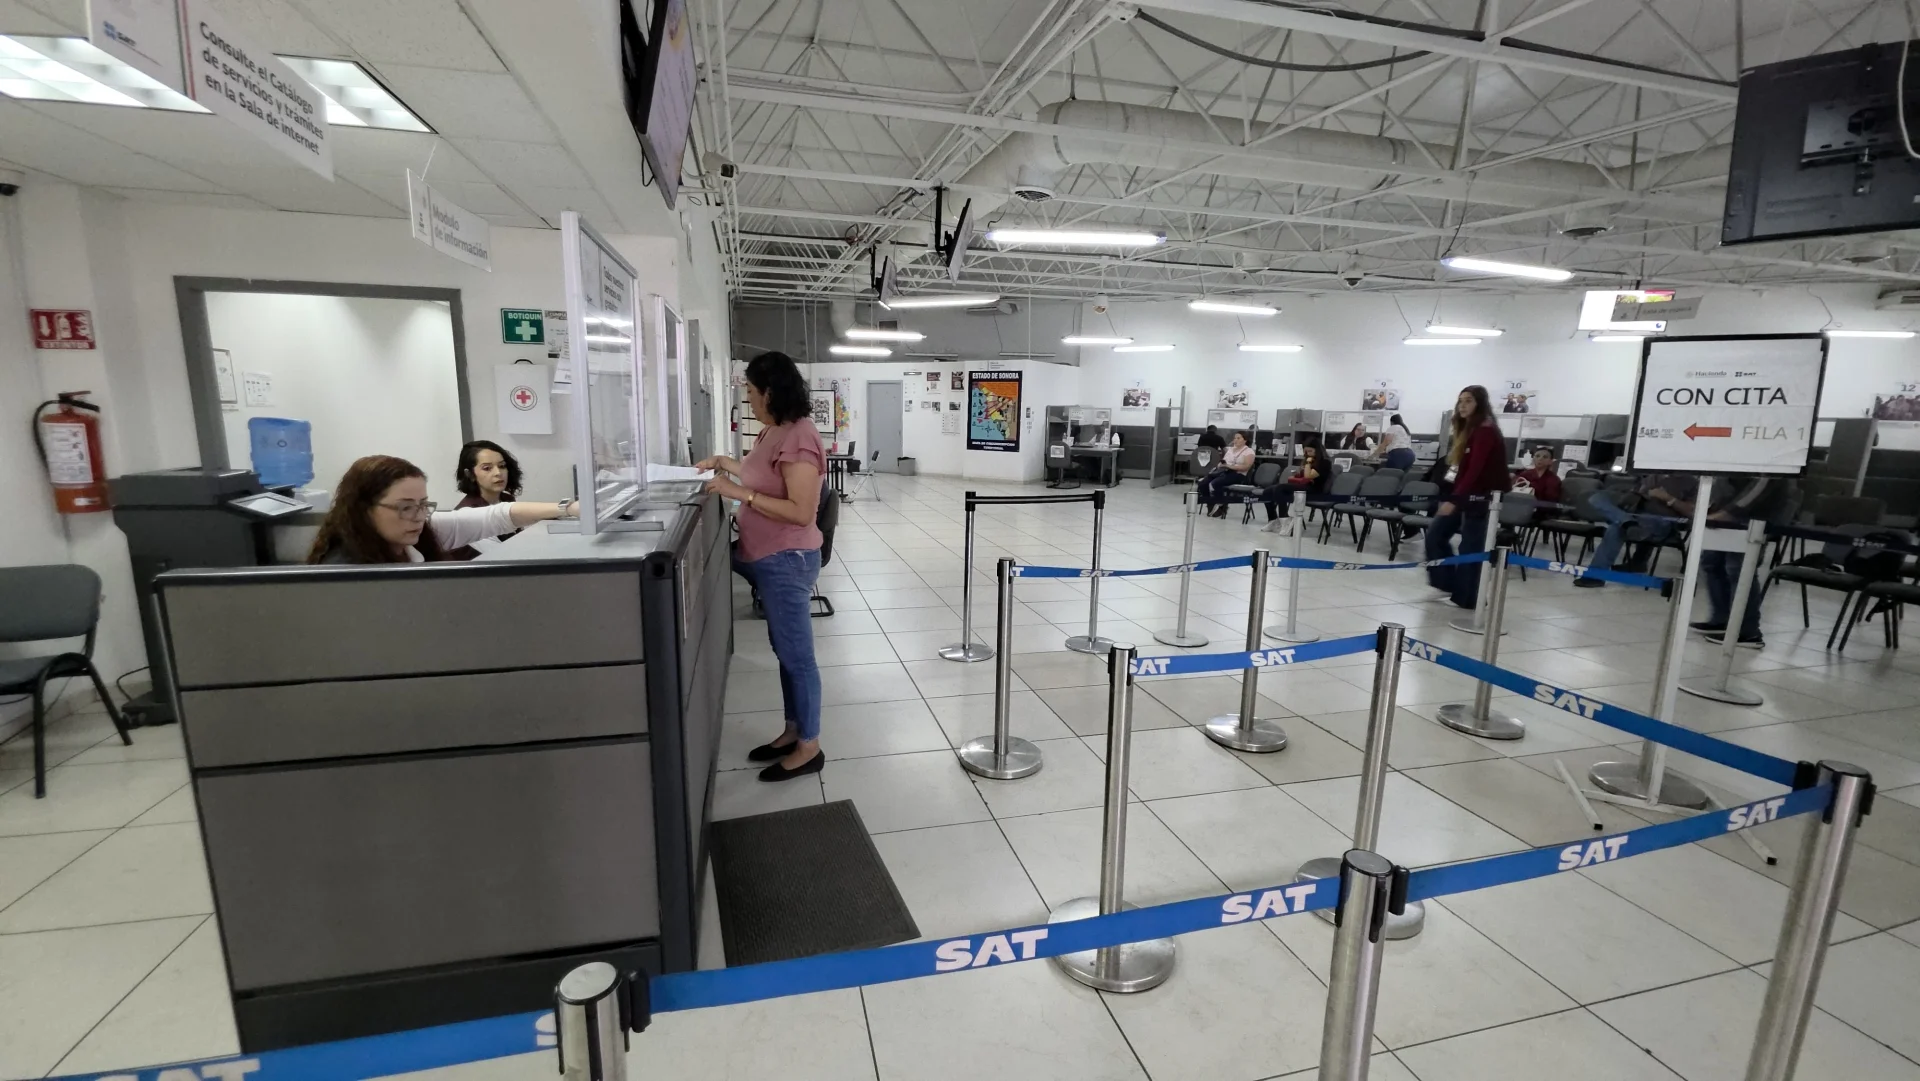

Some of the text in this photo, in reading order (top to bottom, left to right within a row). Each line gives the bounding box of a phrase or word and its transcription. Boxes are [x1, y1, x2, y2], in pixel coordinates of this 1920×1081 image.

[200, 22, 256, 73] Consulte
[258, 66, 268, 82] el
[270, 73, 314, 115] Catálogo
[202, 48, 324, 140] de servicios y trámites
[206, 74, 320, 156] en la Sala de internet
[435, 224, 444, 240] de
[1656, 387, 1788, 405] CON CITA
[1742, 426, 1804, 440] FILA 1
[1166, 564, 1198, 574] SAT
[1548, 562, 1588, 578] SAT
[1250, 649, 1296, 667] SAT
[1534, 684, 1603, 719] SAT
[1726, 798, 1786, 832] SAT
[1558, 836, 1629, 871] SAT
[1221, 884, 1317, 924] SAT
[935, 928, 1048, 972] SAT
